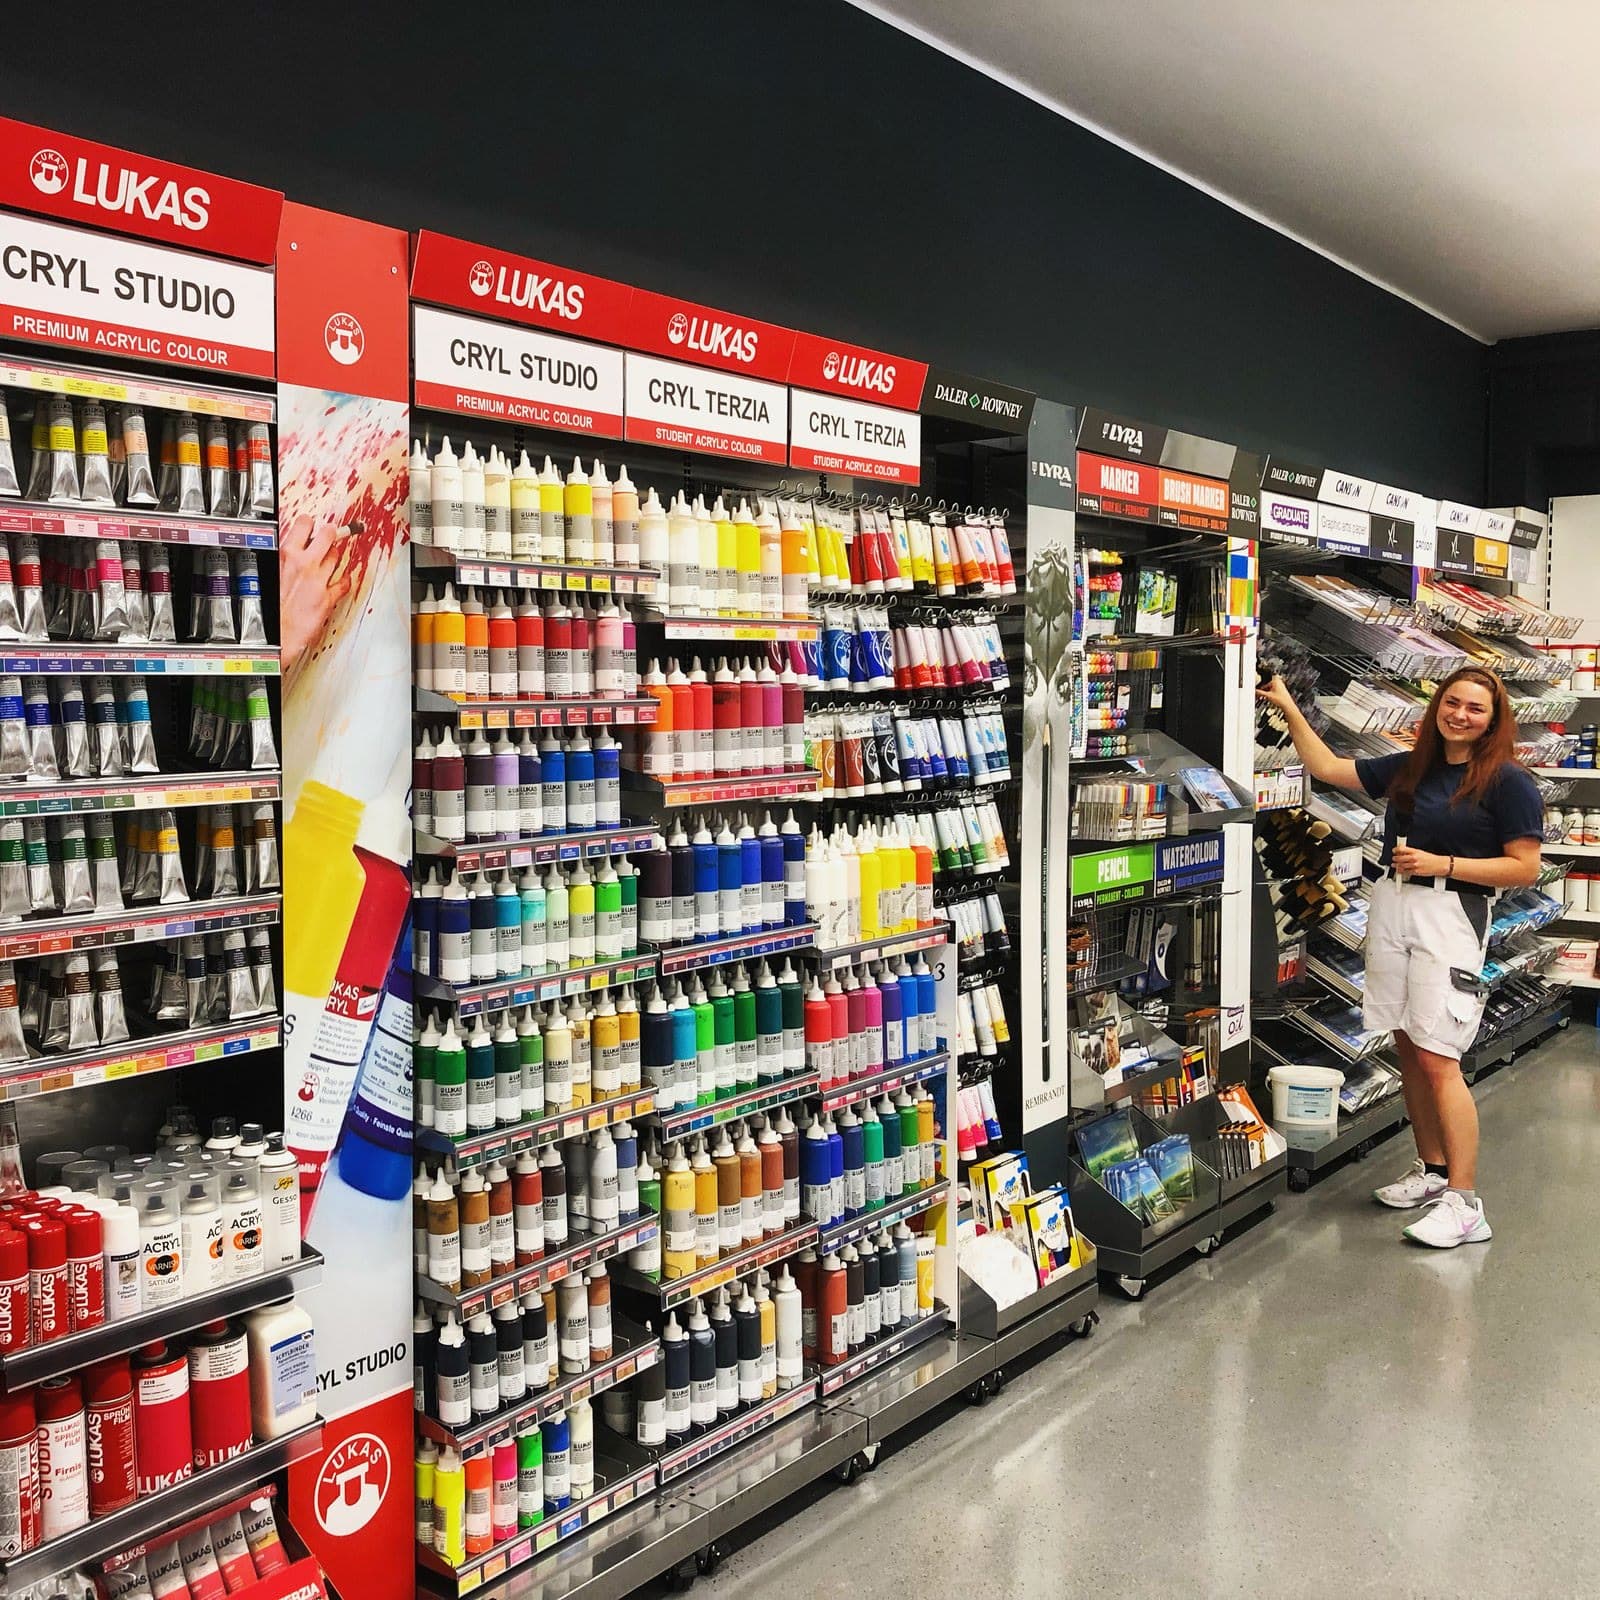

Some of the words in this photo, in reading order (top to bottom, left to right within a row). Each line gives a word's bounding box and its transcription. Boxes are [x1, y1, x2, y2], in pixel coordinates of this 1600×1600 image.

[73, 157, 210, 231] LUKAS
[2, 245, 100, 295] CRYL
[114, 267, 236, 319] STUDIO
[496, 265, 585, 320] LUKAS
[13, 315, 89, 342] PREMIUM
[95, 328, 161, 355] ACRYLIC
[166, 342, 228, 365] COLOUR
[688, 316, 758, 363] LUKAS
[450, 338, 511, 375] CRYL
[519, 352, 598, 391] STUDIO
[838, 356, 896, 394] LUKAS
[456, 394, 505, 415] PREMIUM
[507, 402, 550, 422] ACRYLIC
[553, 410, 593, 430] COLOUR
[648, 378, 700, 411] CRYL
[705, 390, 770, 424] TERZIA
[935, 383, 968, 406] DALER
[981, 395, 1022, 419] ROWNEY
[655, 427, 693, 445] STUDENT
[696, 434, 729, 451] ACRYLIC
[731, 440, 762, 457] COLOUR
[809, 411, 850, 439] CRYL
[854, 420, 906, 449] TERZIA
[1110, 423, 1143, 448] LYRA
[813, 454, 844, 470] STUDENT
[846, 459, 873, 475] ACRYLIC
[874, 464, 900, 479] COLOUR
[1039, 462, 1072, 482] LYRA
[1101, 464, 1140, 495] MARKER
[1163, 478, 1192, 503] BRUSH
[1193, 484, 1225, 511] MARKER
[1231, 493, 1251, 508] DALER
[1231, 504, 1257, 523] ROWNEY
[1272, 505, 1309, 524] GRADUATE
[1163, 840, 1219, 871] WATERCOLOUR
[1098, 856, 1131, 883] PENCIL
[934, 962, 946, 981] 3
[326, 997, 349, 1015] RYL
[1025, 1086, 1064, 1111] REMBRANDT
[1186, 1092, 1191, 1103] 5
[373, 1118, 394, 1134] Feinste
[272, 1194, 297, 1205] GESSO
[153, 1233, 174, 1241] GHIANT
[42, 1274, 56, 1319] LUKAS
[75, 1263, 89, 1307] LUKAS
[345, 1342, 407, 1381] STUDIO
[103, 1405, 131, 1421] SPRÜH
[113, 1412, 131, 1426] FILM
[88, 1413, 104, 1468] LUKAS
[38, 1427, 53, 1500] STUDIO
[55, 1463, 81, 1477] Firnis
[323, 1441, 383, 1484] LUKAS
[137, 1462, 193, 1496] LUKAS
[217, 1529, 243, 1549] LUKAS
[247, 1517, 273, 1535] LUKAS
[120, 1545, 147, 1562] LUKAS
[185, 1544, 213, 1564] LUKAS
[154, 1560, 180, 1580] LUKAS
[119, 1575, 148, 1594] LUKAS
